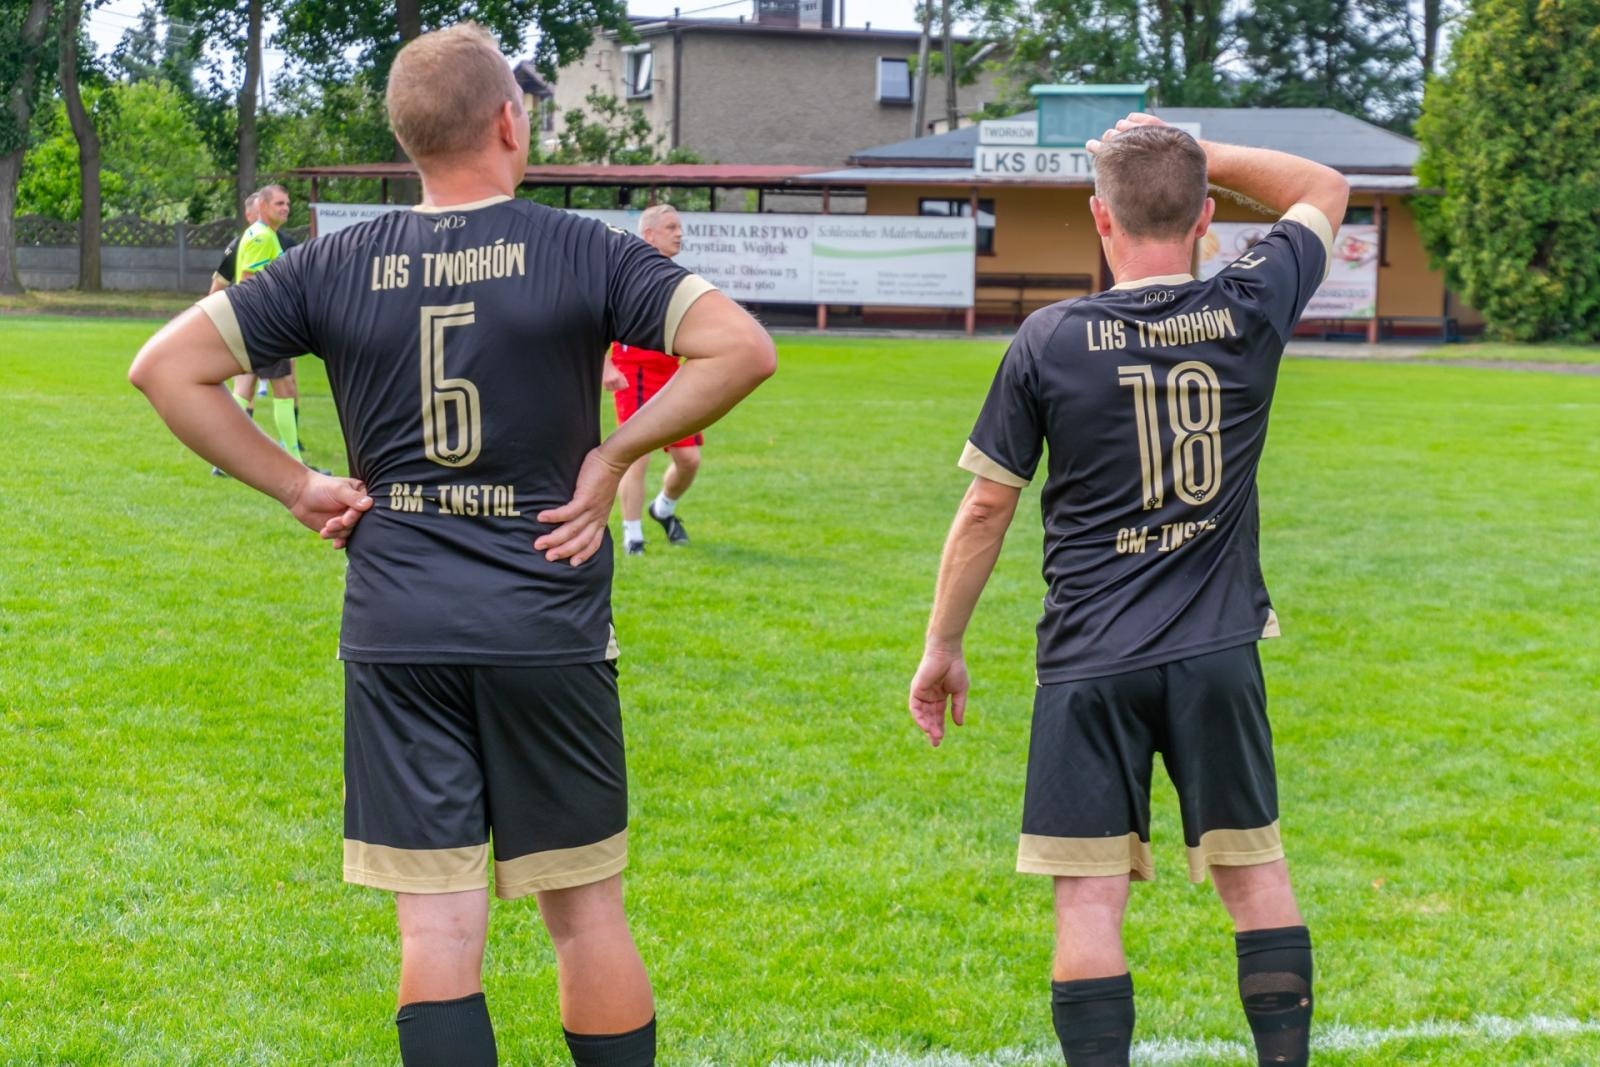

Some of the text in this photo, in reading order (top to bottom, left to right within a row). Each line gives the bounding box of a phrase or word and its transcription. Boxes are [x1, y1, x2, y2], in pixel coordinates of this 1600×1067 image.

[981, 153, 1025, 173] LKS
[1035, 153, 1061, 173] 05
[319, 209, 347, 218] PRACA
[350, 209, 359, 217] W
[434, 215, 466, 233] 1905
[881, 226, 969, 240] Malerhandwerk
[371, 238, 526, 291] LKS TWORKÓW
[1143, 289, 1176, 306] 1905
[1086, 304, 1237, 352] LKS TWORKÓW
[420, 301, 482, 468] 6
[1117, 360, 1223, 511] 18
